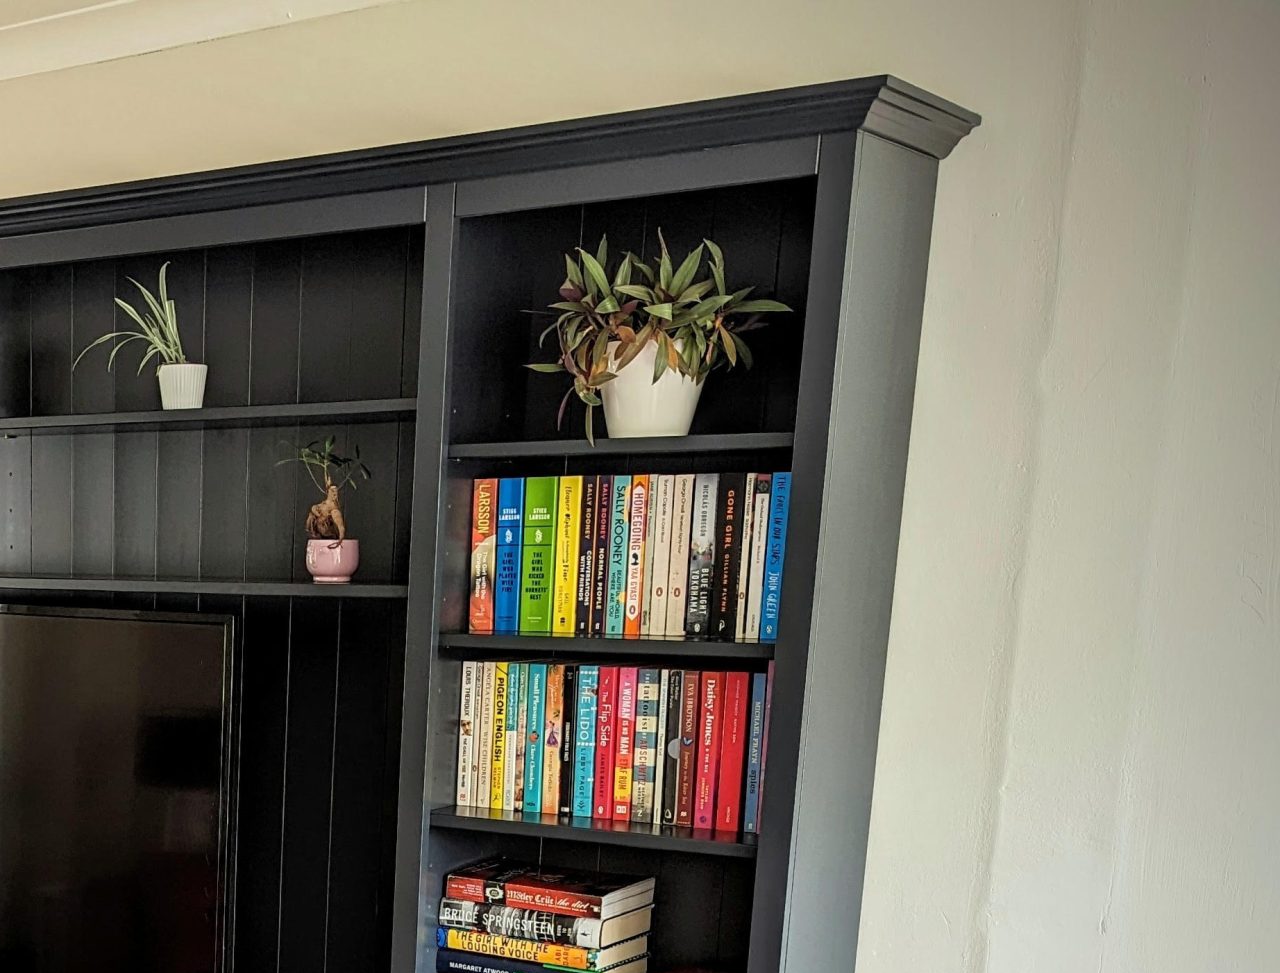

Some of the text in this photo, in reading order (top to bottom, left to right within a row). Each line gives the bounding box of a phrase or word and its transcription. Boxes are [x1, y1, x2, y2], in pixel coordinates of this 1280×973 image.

[478, 484, 491, 534] LARSSON
[726, 490, 735, 520] GONE
[613, 486, 625, 565] SALLY ROONEY
[631, 493, 644, 551] HOMEGOING
[724, 525, 732, 549] GIRL
[584, 550, 592, 606] CONVERSATIONS
[689, 570, 700, 613] YOKOHAMA
[699, 568, 709, 614] BLUE LIGHT
[768, 572, 779, 590] JOHN
[766, 593, 777, 619] GREEN
[582, 677, 591, 704] THE
[622, 688, 632, 719] WOMAN
[705, 680, 716, 711] Daisy
[580, 708, 590, 738] LIDO
[598, 704, 612, 722] Flip
[494, 718, 503, 762] ENGLISH
[600, 725, 610, 746] Side
[705, 712, 714, 746] Jones
[620, 737, 629, 754] MAN
[638, 740, 648, 786] AUSCHWITZ
[445, 908, 554, 935] BRUCE SPRINGSTEEN
[457, 931, 548, 953] THE GIRL WITH THE
[462, 942, 538, 960] LOUDING VOICE
[449, 962, 482, 972] MARGARET
